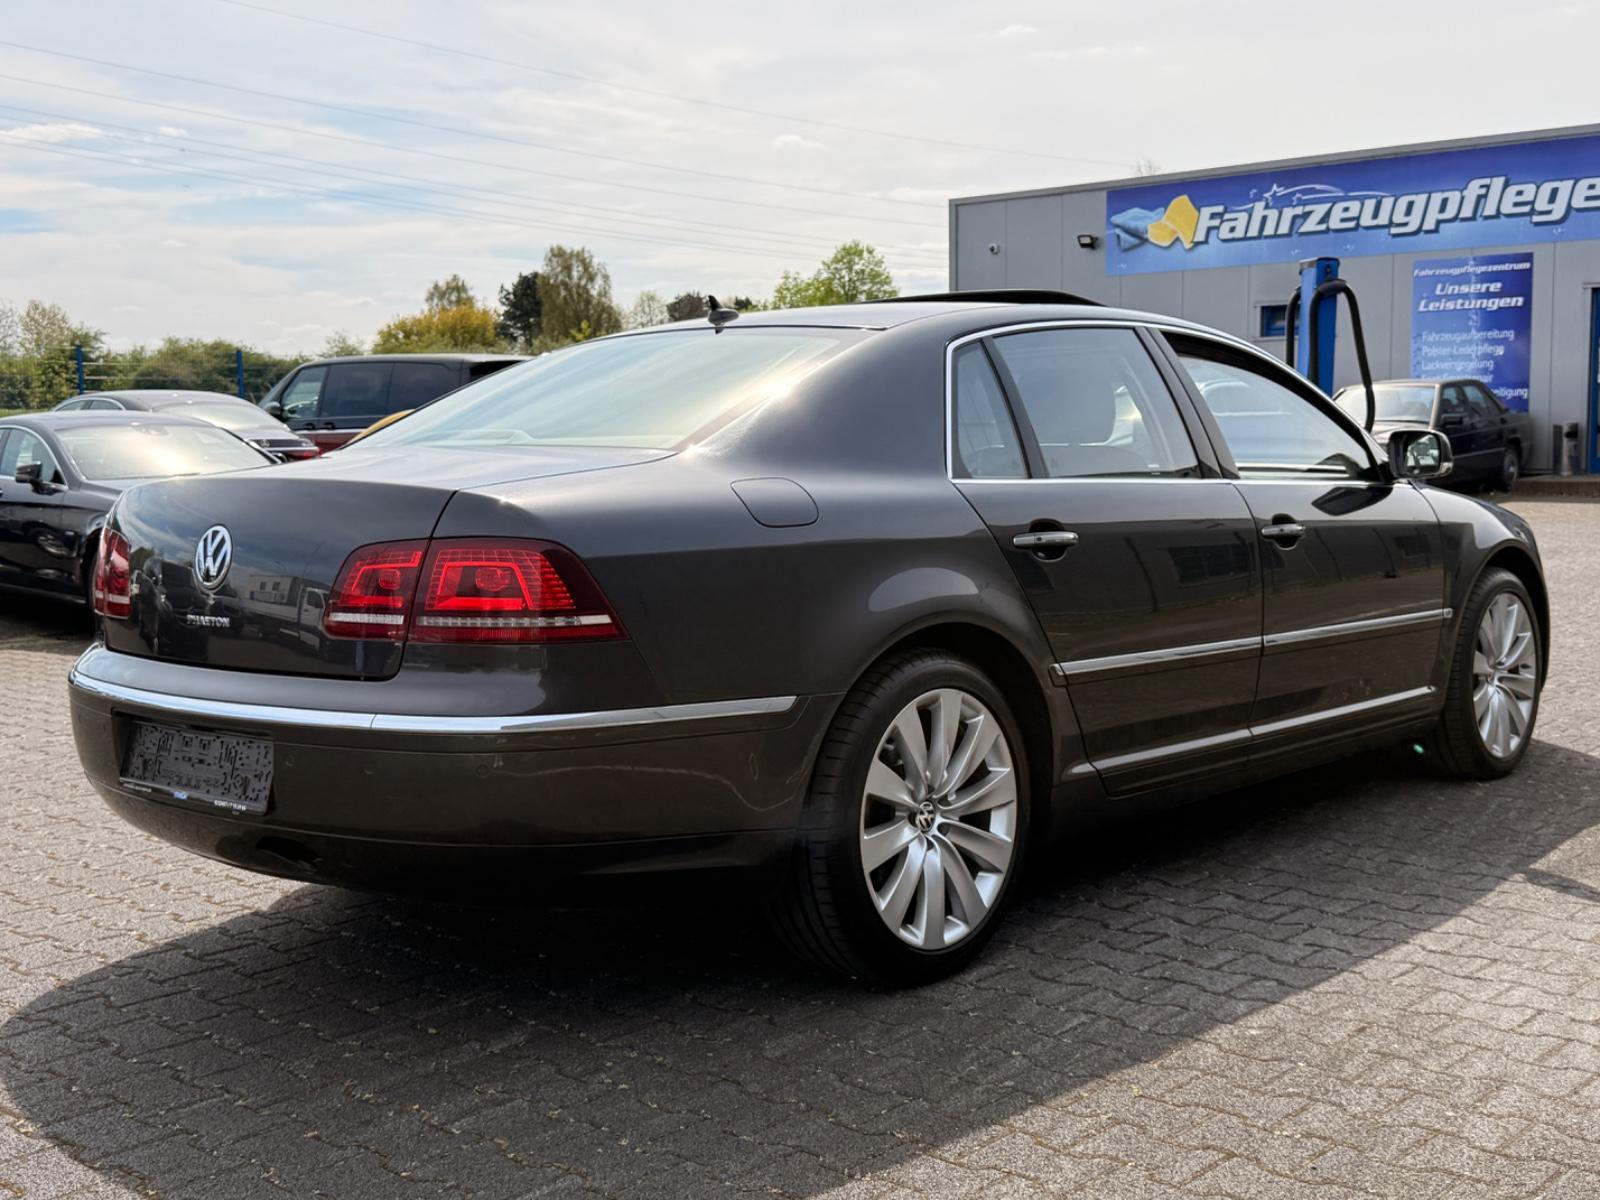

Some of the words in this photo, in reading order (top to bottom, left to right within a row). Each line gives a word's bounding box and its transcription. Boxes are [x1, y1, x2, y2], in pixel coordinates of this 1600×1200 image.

[1194, 176, 1600, 243] Fahrzeugpflege
[1413, 262, 1531, 277] Fahrzeugpflegezentrum
[1435, 281, 1502, 296] Unsere
[1418, 296, 1524, 312] Leistungen
[196, 525, 232, 589] VW
[187, 614, 231, 628] PHAETON
